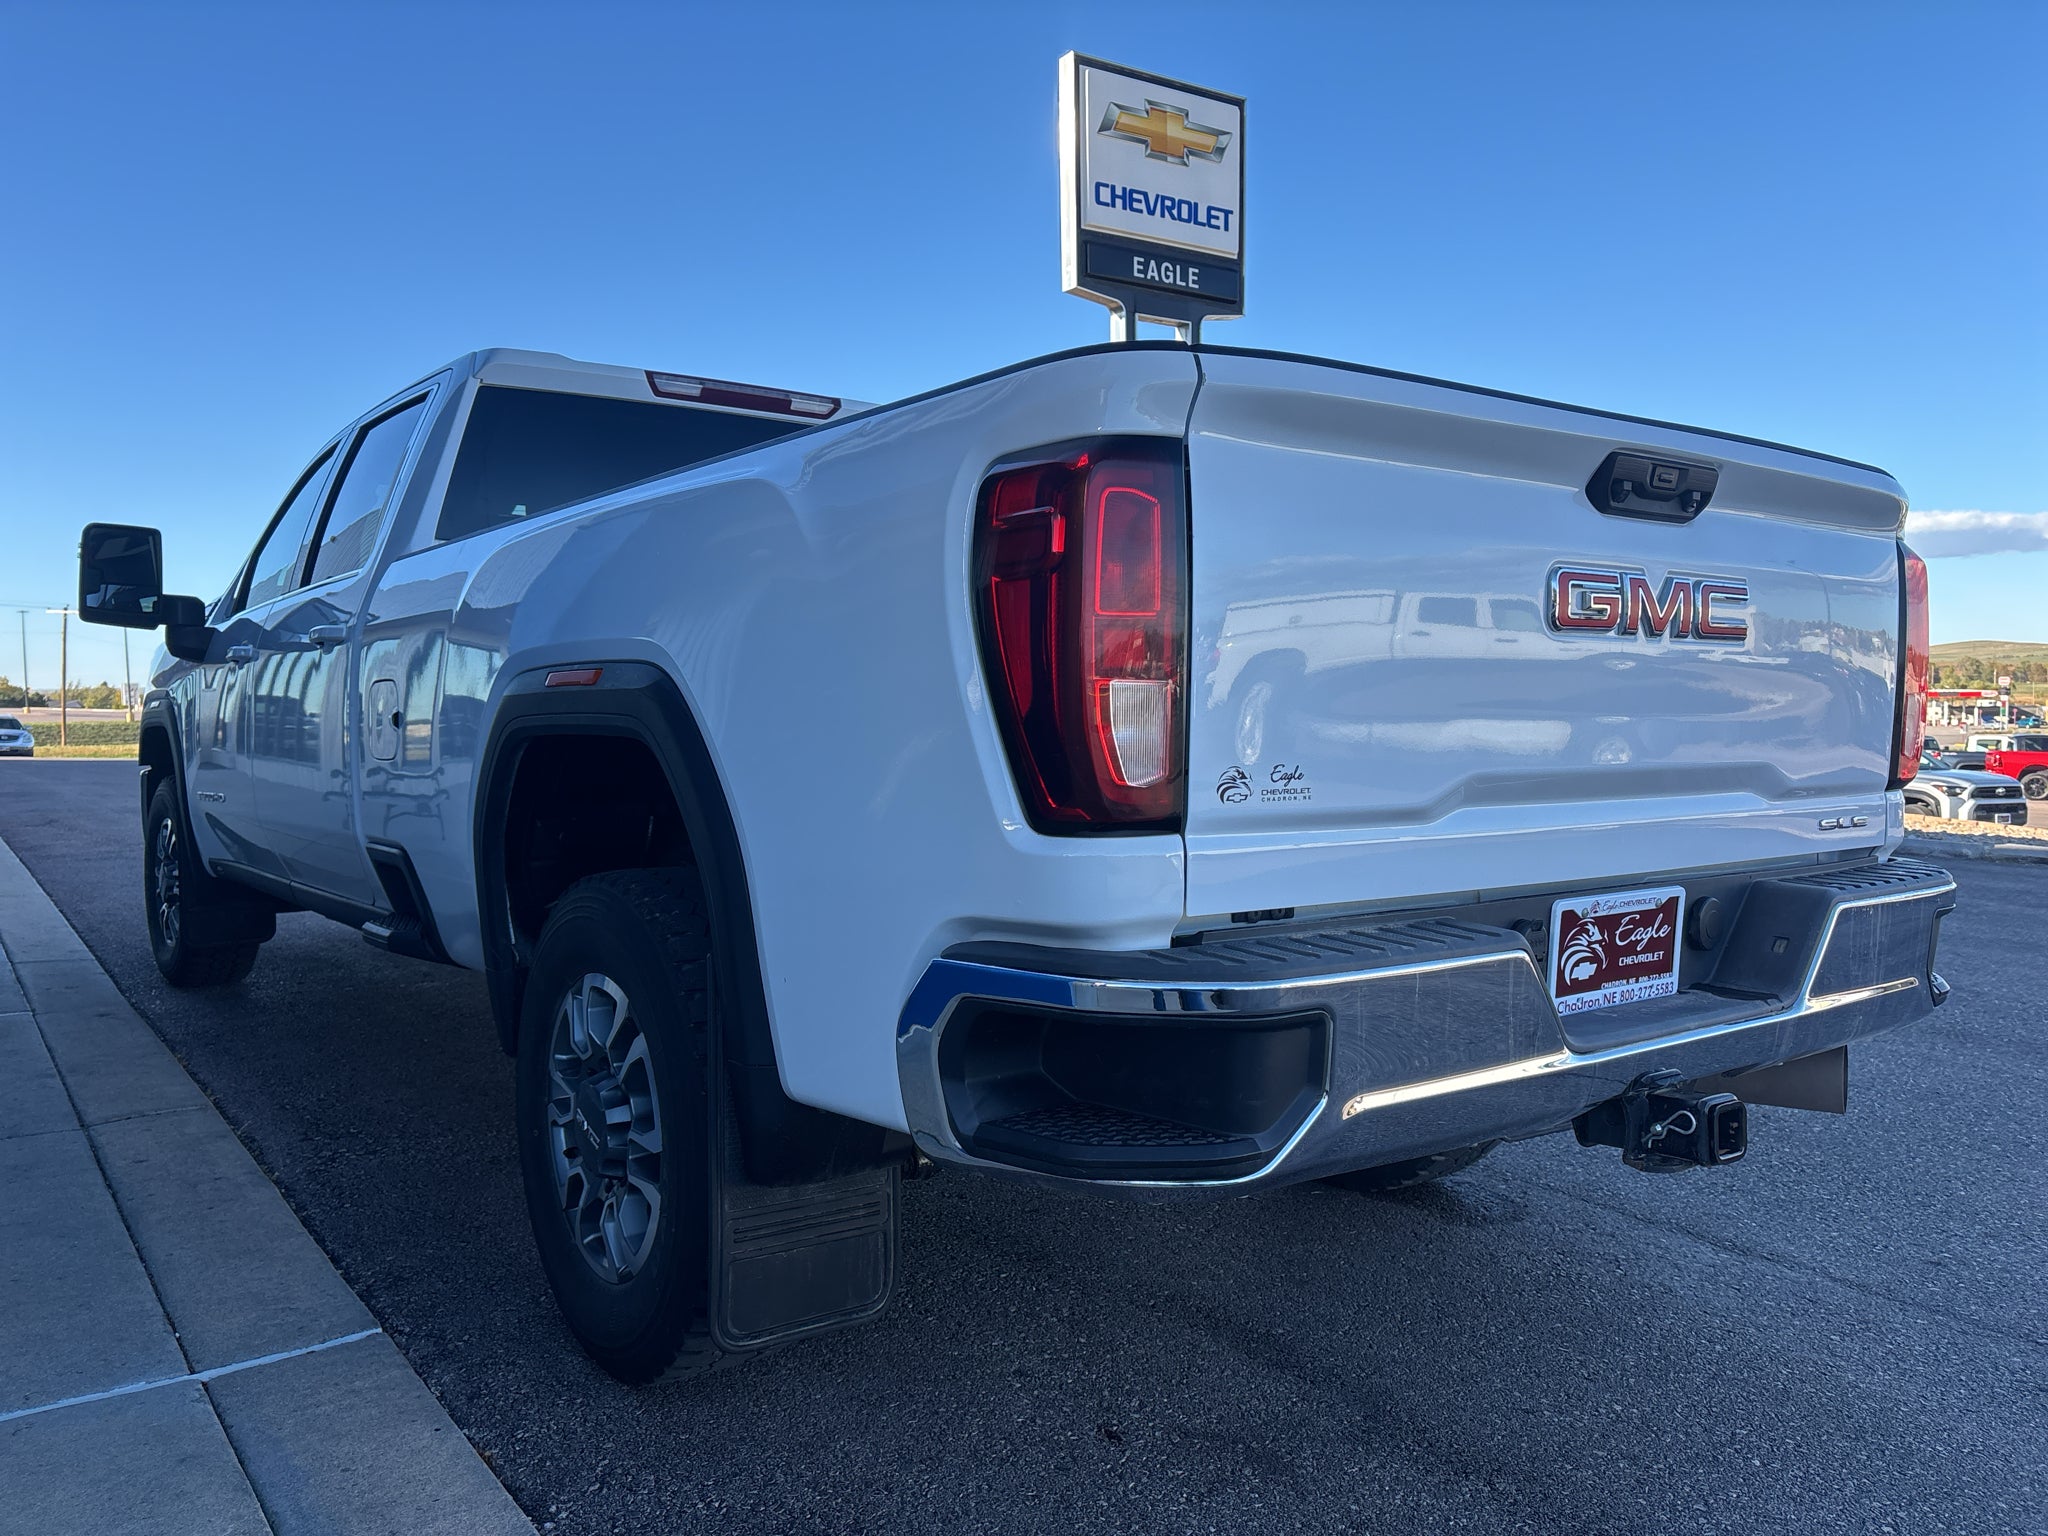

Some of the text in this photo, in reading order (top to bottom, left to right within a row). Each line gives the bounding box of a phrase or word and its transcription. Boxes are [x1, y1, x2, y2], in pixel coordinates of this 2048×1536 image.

[1094, 181, 1233, 232] CHEVROLET
[1132, 256, 1200, 289] EAGLE
[1551, 566, 1749, 641] GMC
[1270, 763, 1304, 787] Eagle
[1261, 787, 1311, 796] CHEVROLET
[1819, 816, 1868, 830] SLE
[1603, 896, 1657, 913] Eagle CHEVROLET
[1615, 912, 1671, 951] Eagle
[1619, 951, 1665, 966] CHEVROLET
[1620, 982, 1674, 1002] 800-272-5583
